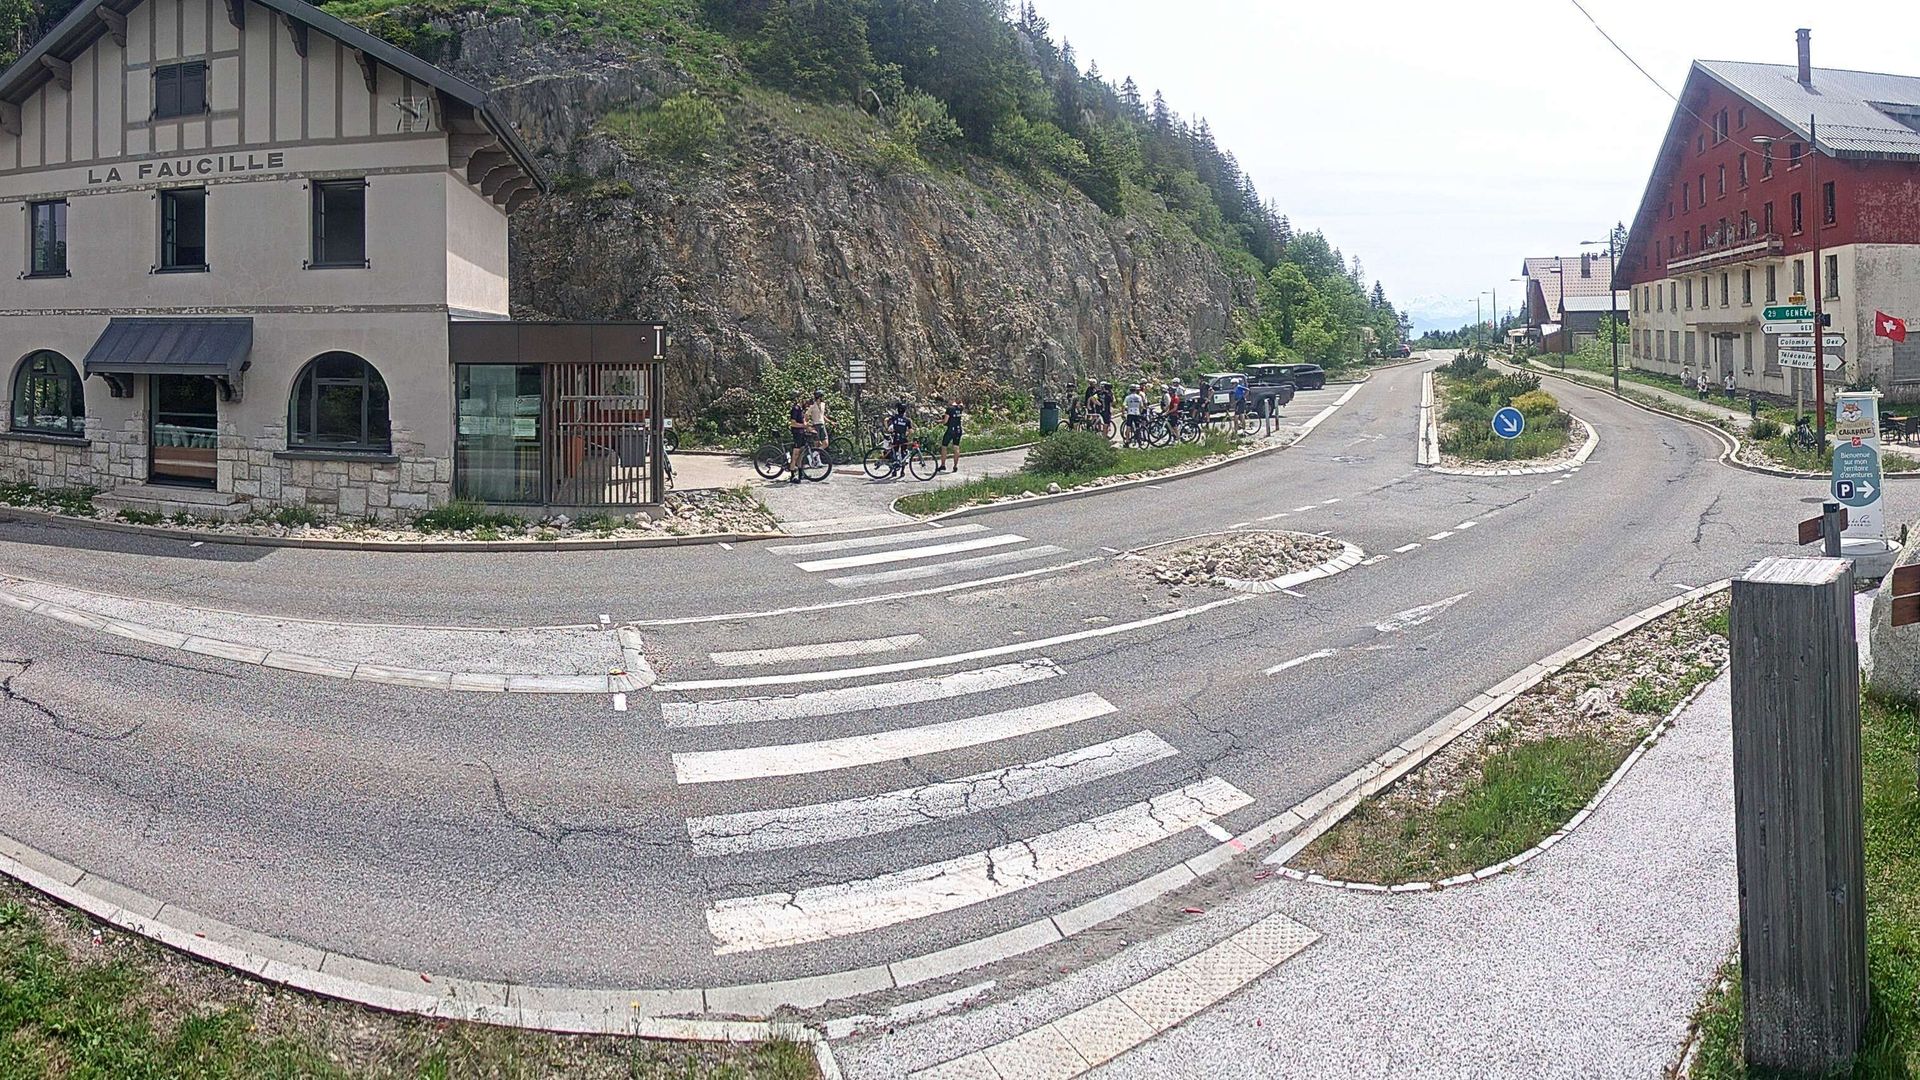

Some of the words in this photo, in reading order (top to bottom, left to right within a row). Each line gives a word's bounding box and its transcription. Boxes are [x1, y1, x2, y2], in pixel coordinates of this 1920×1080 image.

[88, 167, 122, 185] LA
[138, 152, 284, 180] FAUCILLE
[1841, 484, 1850, 497] P
